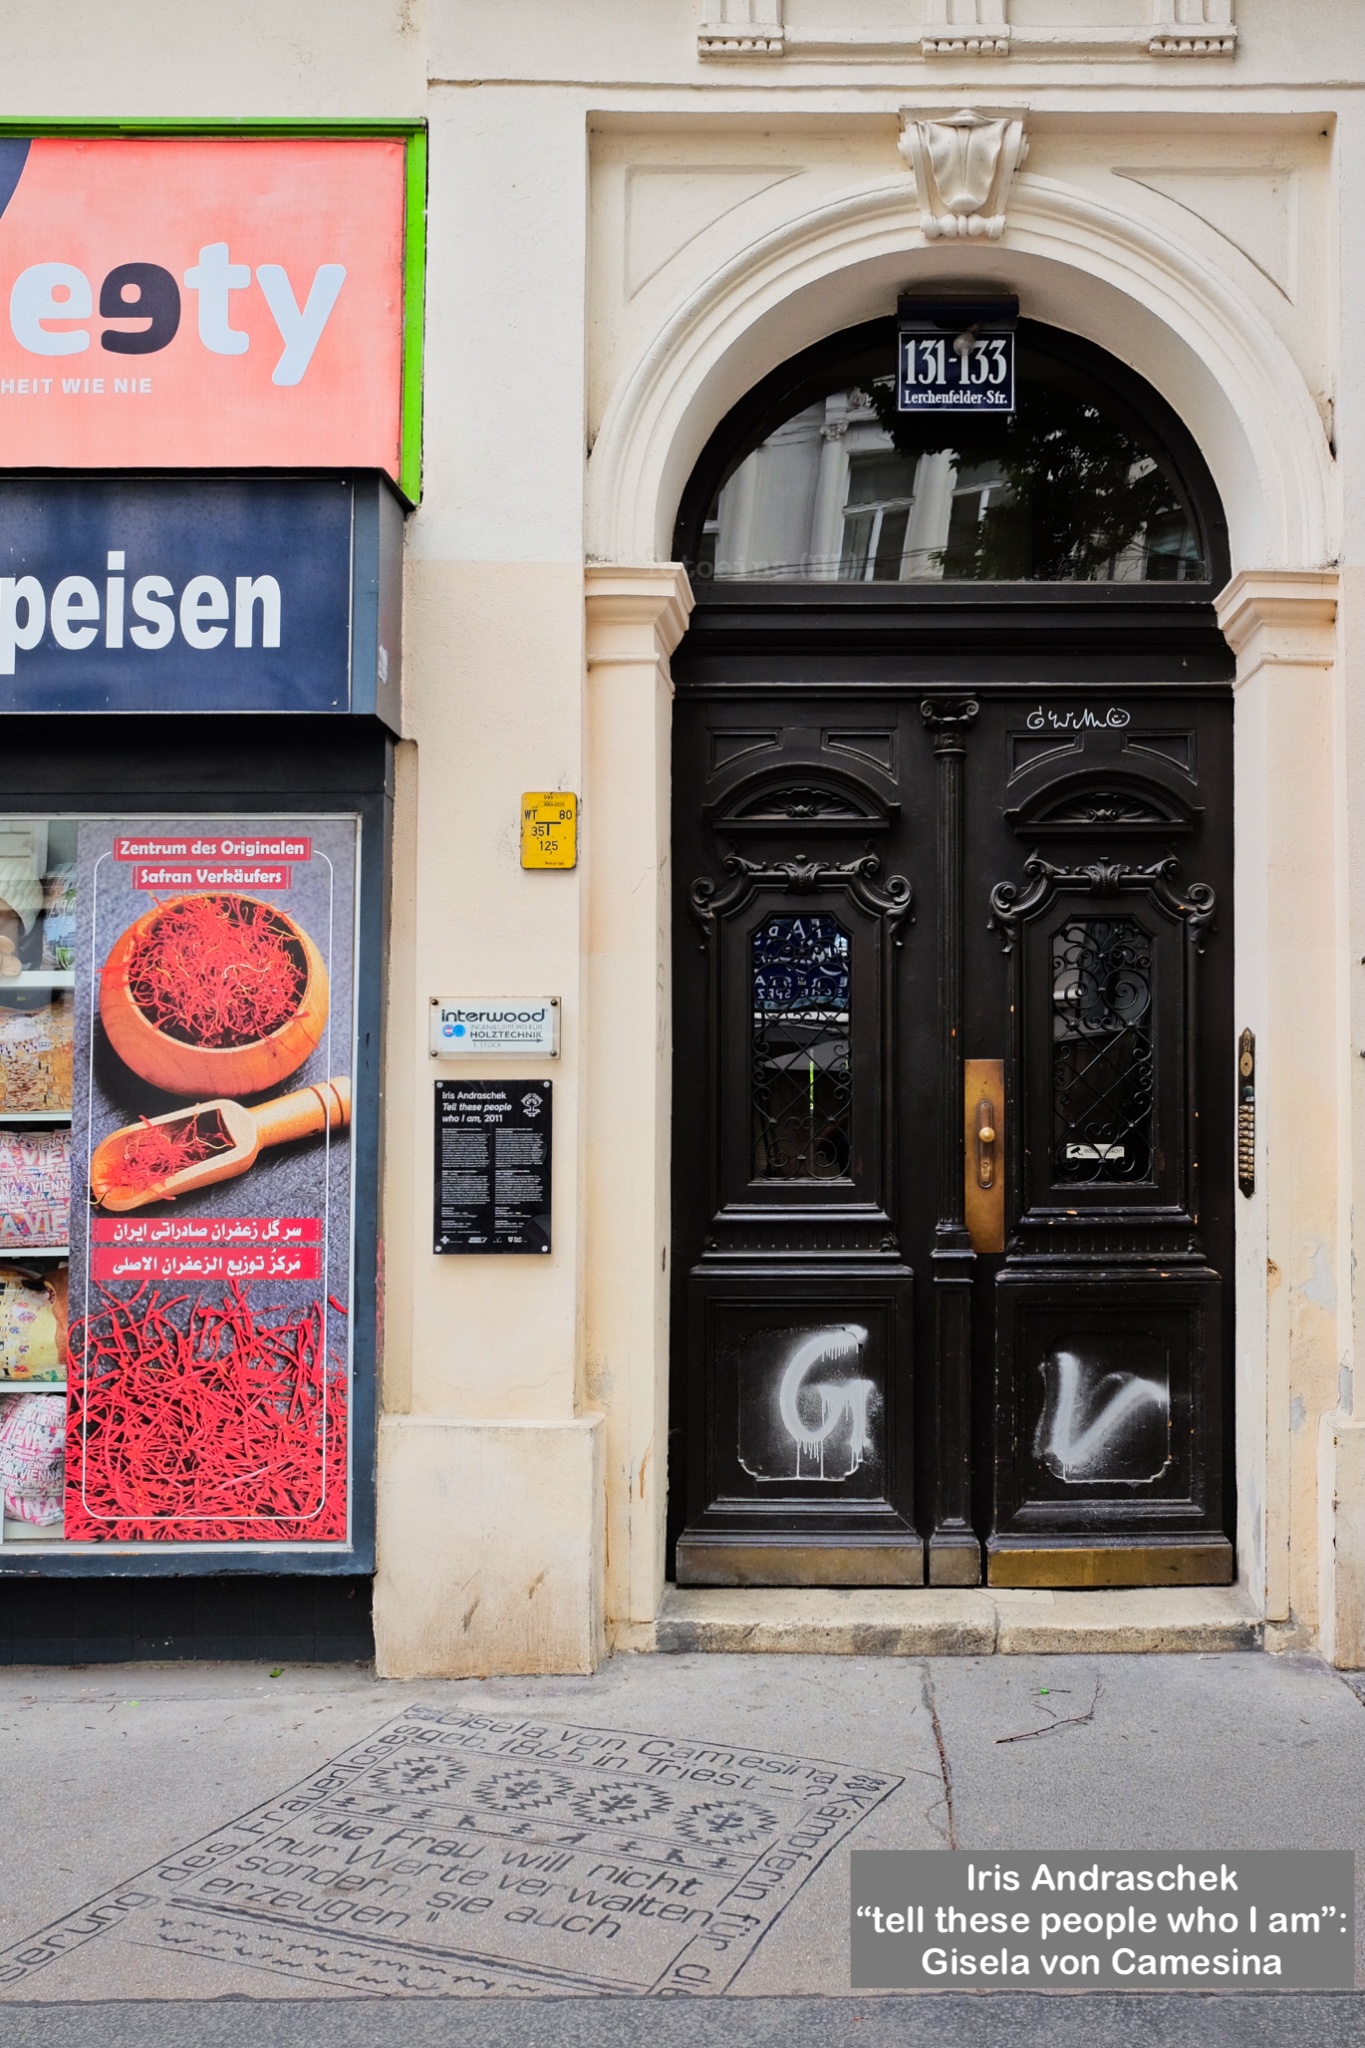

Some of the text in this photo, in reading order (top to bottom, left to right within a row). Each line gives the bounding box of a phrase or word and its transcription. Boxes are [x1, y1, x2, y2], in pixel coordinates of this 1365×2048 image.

[0, 378, 152, 394] HEIT WIE NIE
[904, 390, 1008, 404] Lerchenfelder-Str.
[524, 810, 573, 820] WT 80
[531, 826, 545, 837] 35
[120, 840, 304, 857] Zentrum des Originalen
[539, 841, 558, 851] 125
[141, 868, 282, 884] Safran Verkäufers
[441, 1008, 545, 1023] interwood
[470, 1030, 543, 1039] HOLZTECHNIK
[442, 1091, 507, 1100] Iris Andraschek
[443, 1103, 512, 1112] Tell these people
[466, 1115, 481, 1123] am,
[484, 1114, 503, 1122] 2011
[113, 1223, 147, 1242] ایران
[211, 1221, 258, 1241] زعفران
[498, 1739, 590, 1763] 1865
[592, 1752, 629, 1769] in
[645, 1756, 763, 1791] Triest
[560, 1730, 626, 1750] von
[638, 1740, 838, 1785] Camesina
[733, 1792, 873, 1901] Kämpferin
[158, 1842, 239, 1881] des
[262, 1836, 339, 1858] nur
[345, 1845, 489, 1886] Werte
[381, 1827, 486, 1858] Frau
[501, 1850, 575, 1872] will
[587, 1862, 704, 1897] nicht
[236, 1856, 622, 1939] sondern sie auch
[701, 1911, 761, 1951] für
